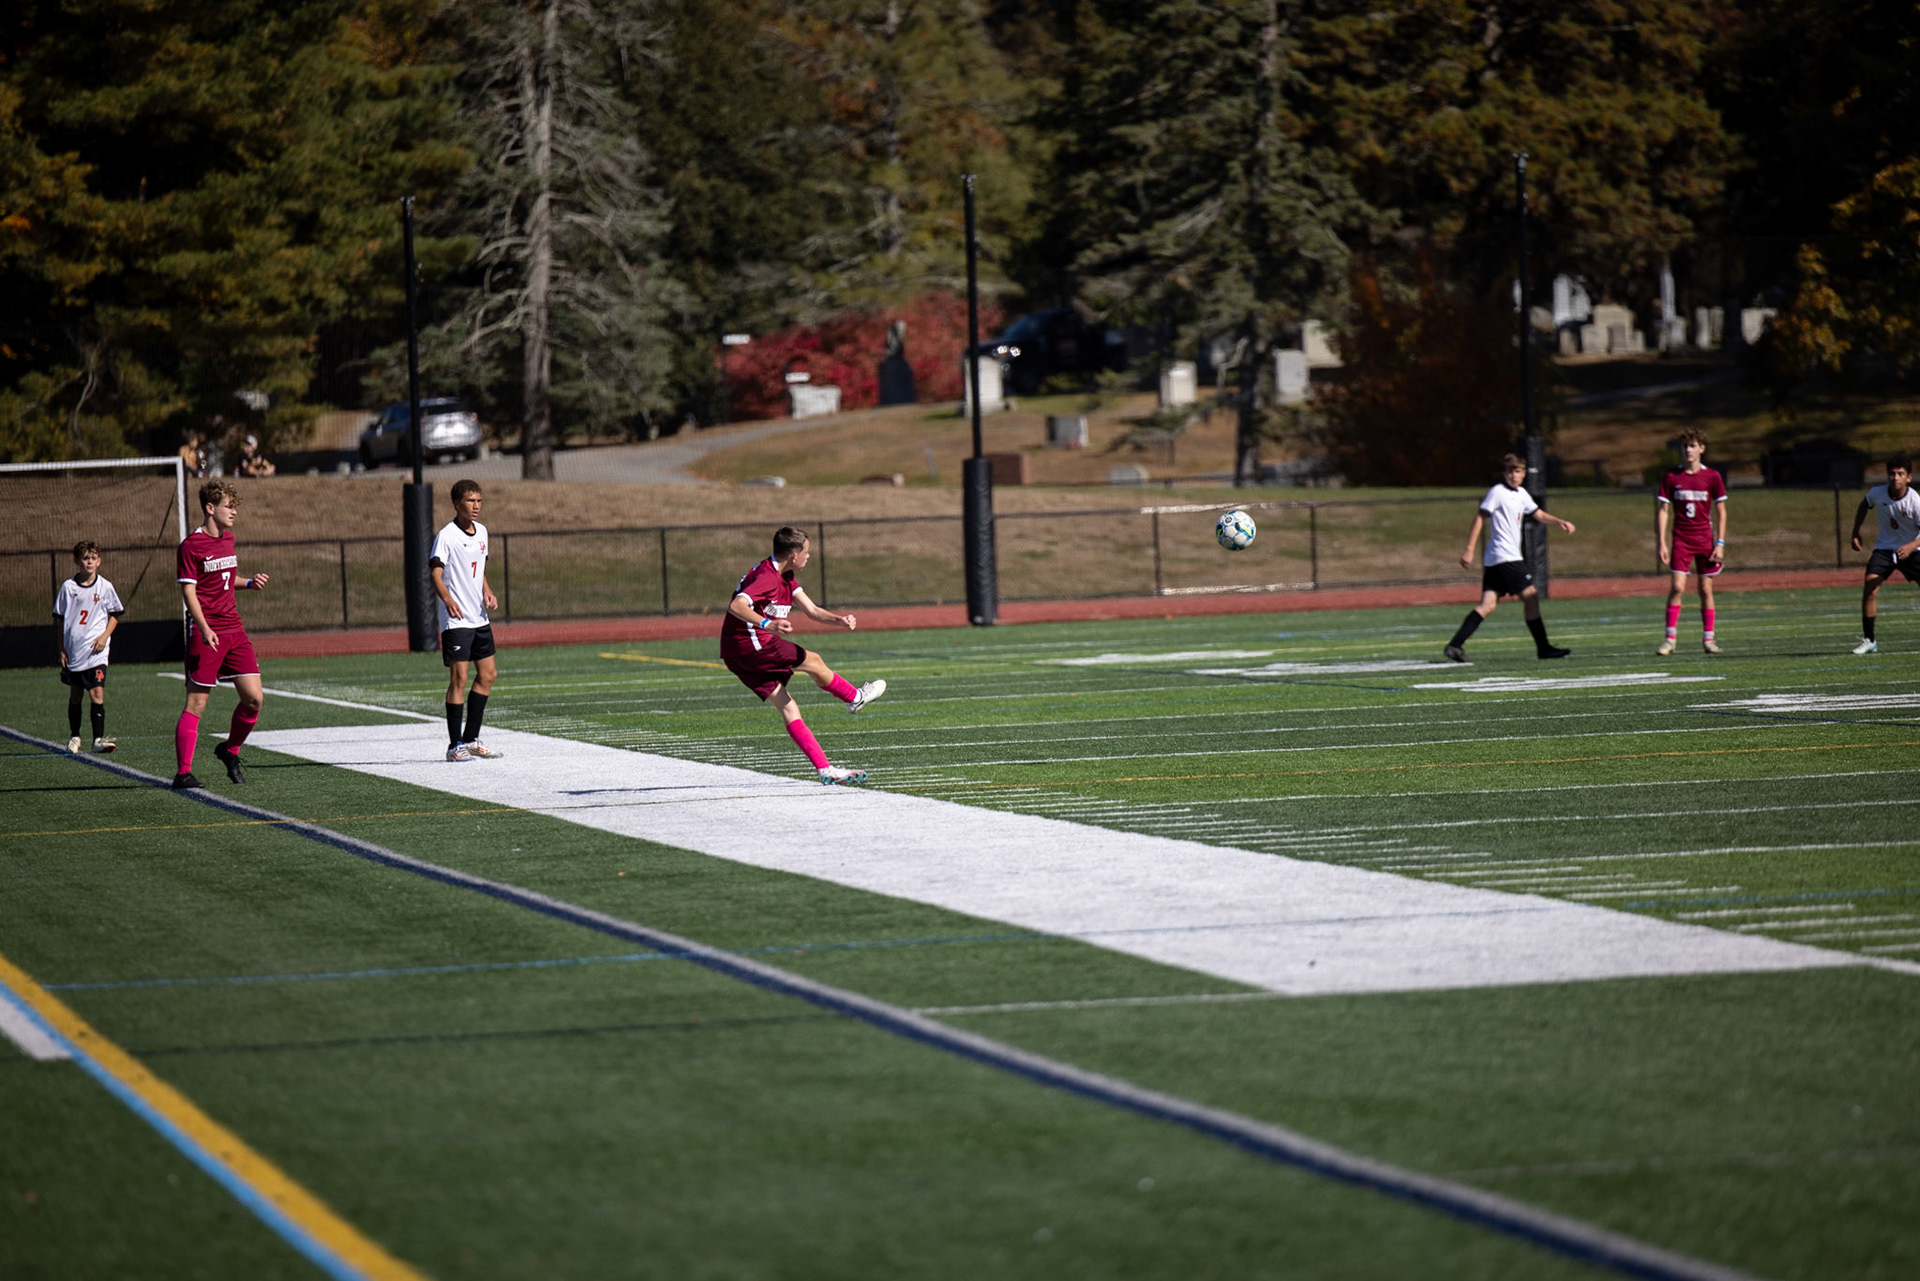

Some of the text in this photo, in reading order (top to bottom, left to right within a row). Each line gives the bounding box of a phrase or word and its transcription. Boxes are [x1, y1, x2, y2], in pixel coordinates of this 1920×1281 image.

[1686, 502, 1696, 518] 3
[471, 561, 477, 578] 7
[221, 571, 231, 591] 7
[79, 609, 89, 625] 2
